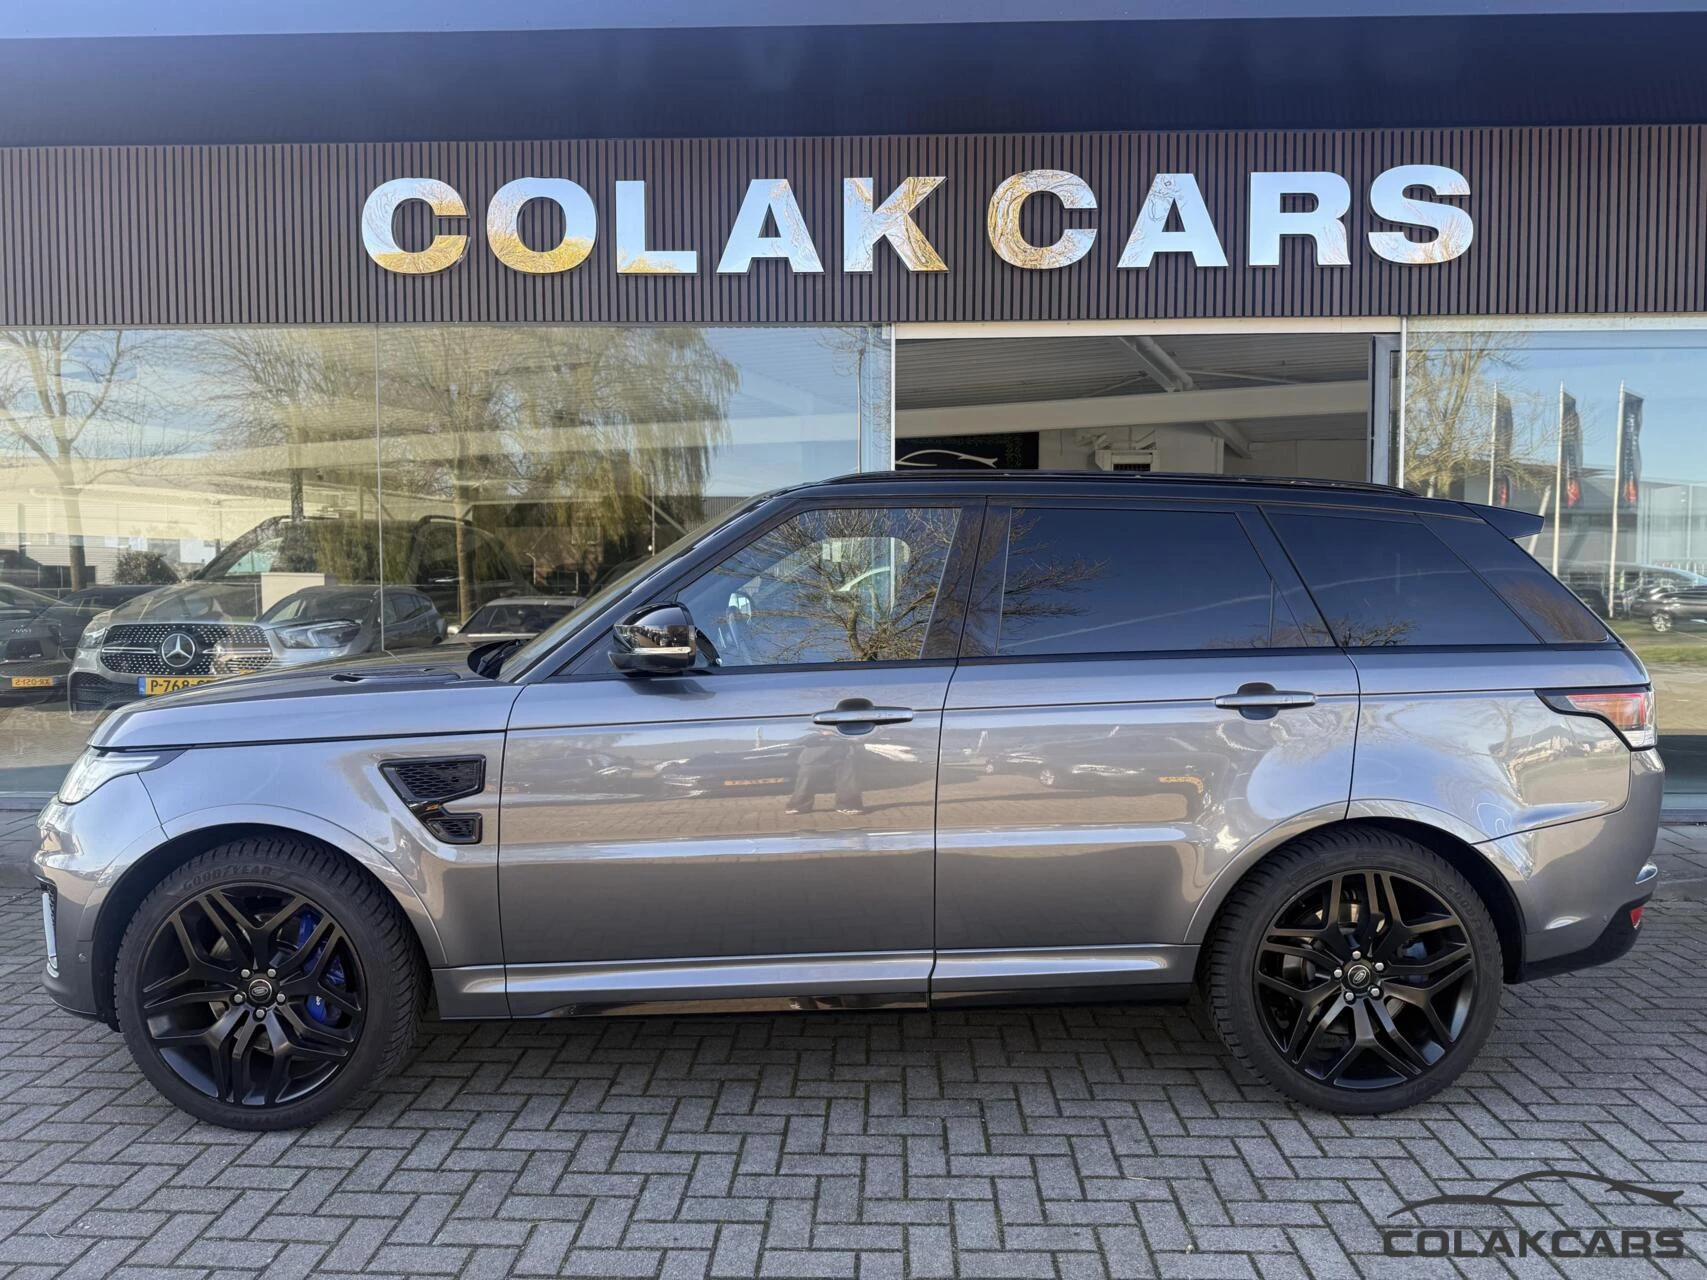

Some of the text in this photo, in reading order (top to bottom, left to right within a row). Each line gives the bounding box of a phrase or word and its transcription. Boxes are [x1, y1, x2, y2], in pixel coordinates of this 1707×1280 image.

[361, 164, 1473, 273] COLAK CARS
[151, 680, 213, 692] P-768-
